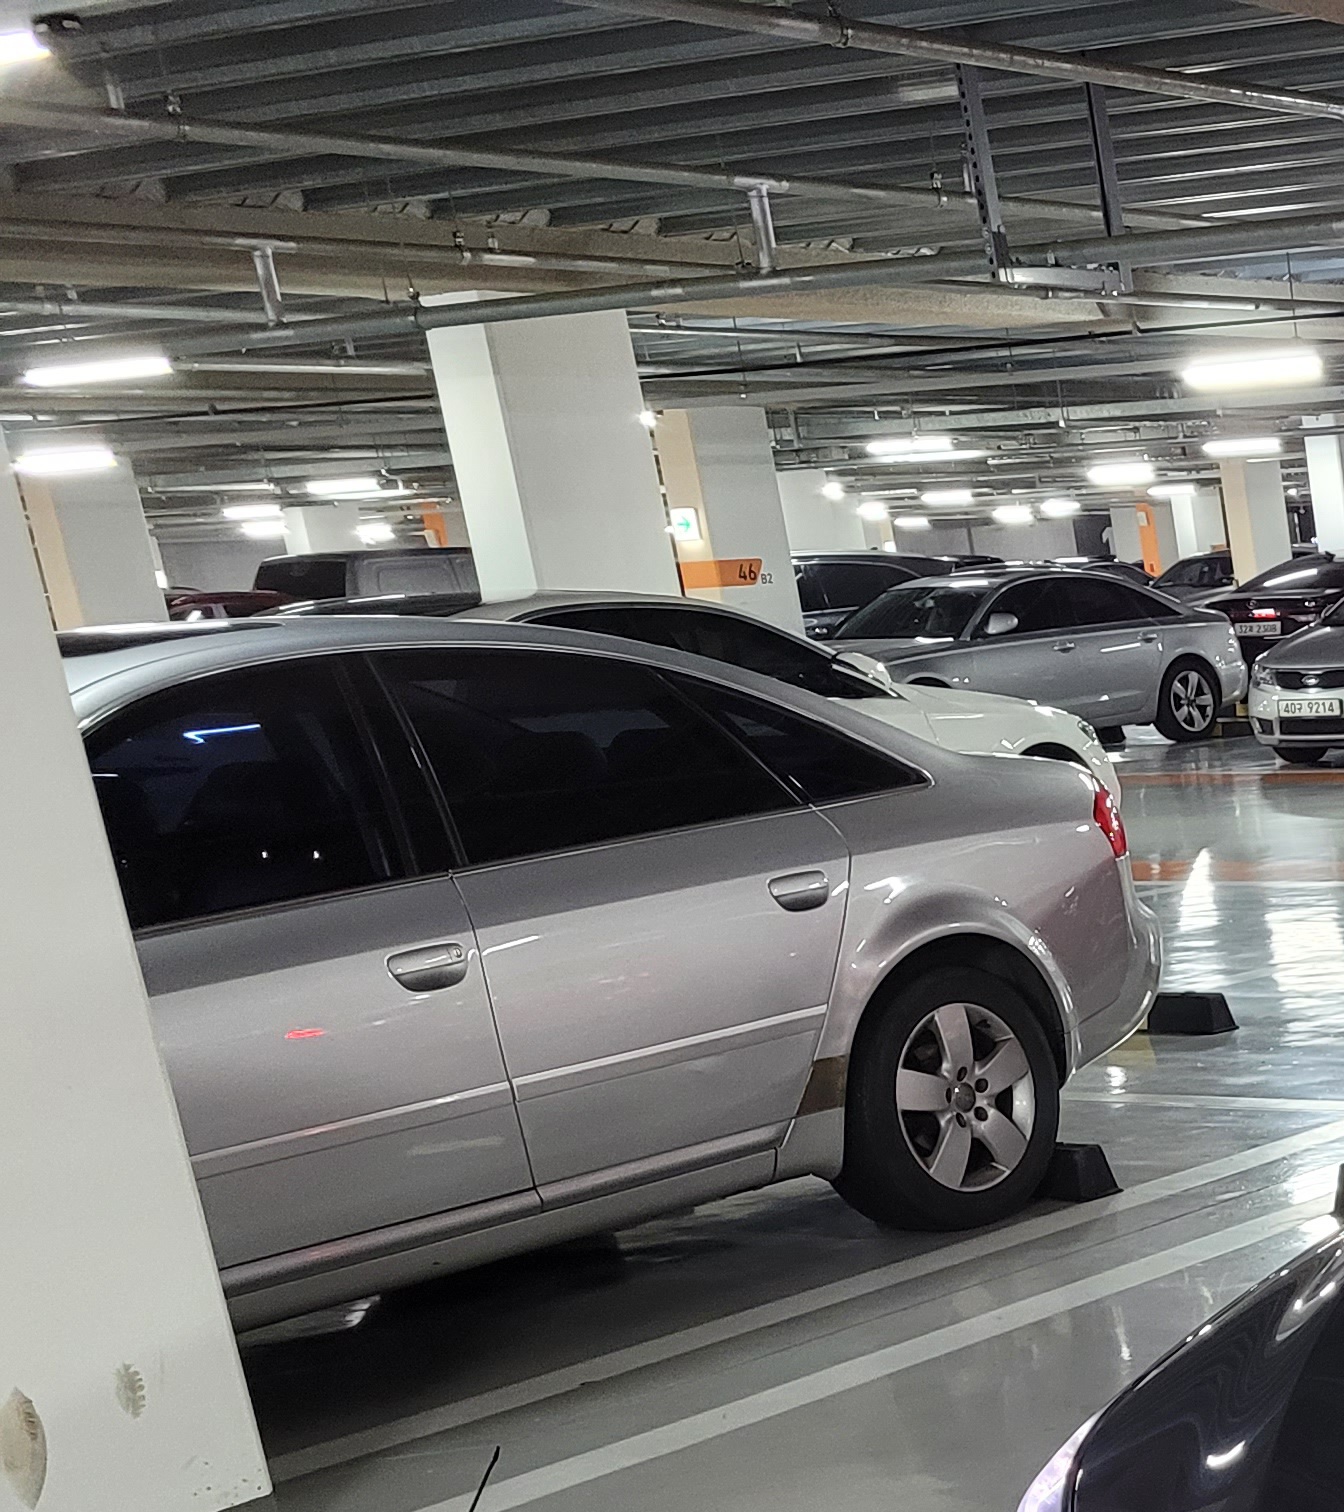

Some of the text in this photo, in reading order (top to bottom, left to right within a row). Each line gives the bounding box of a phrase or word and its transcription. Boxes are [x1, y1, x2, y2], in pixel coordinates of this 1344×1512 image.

[738, 563, 773, 584] 46 B2
[1307, 701, 1335, 714] 9214
